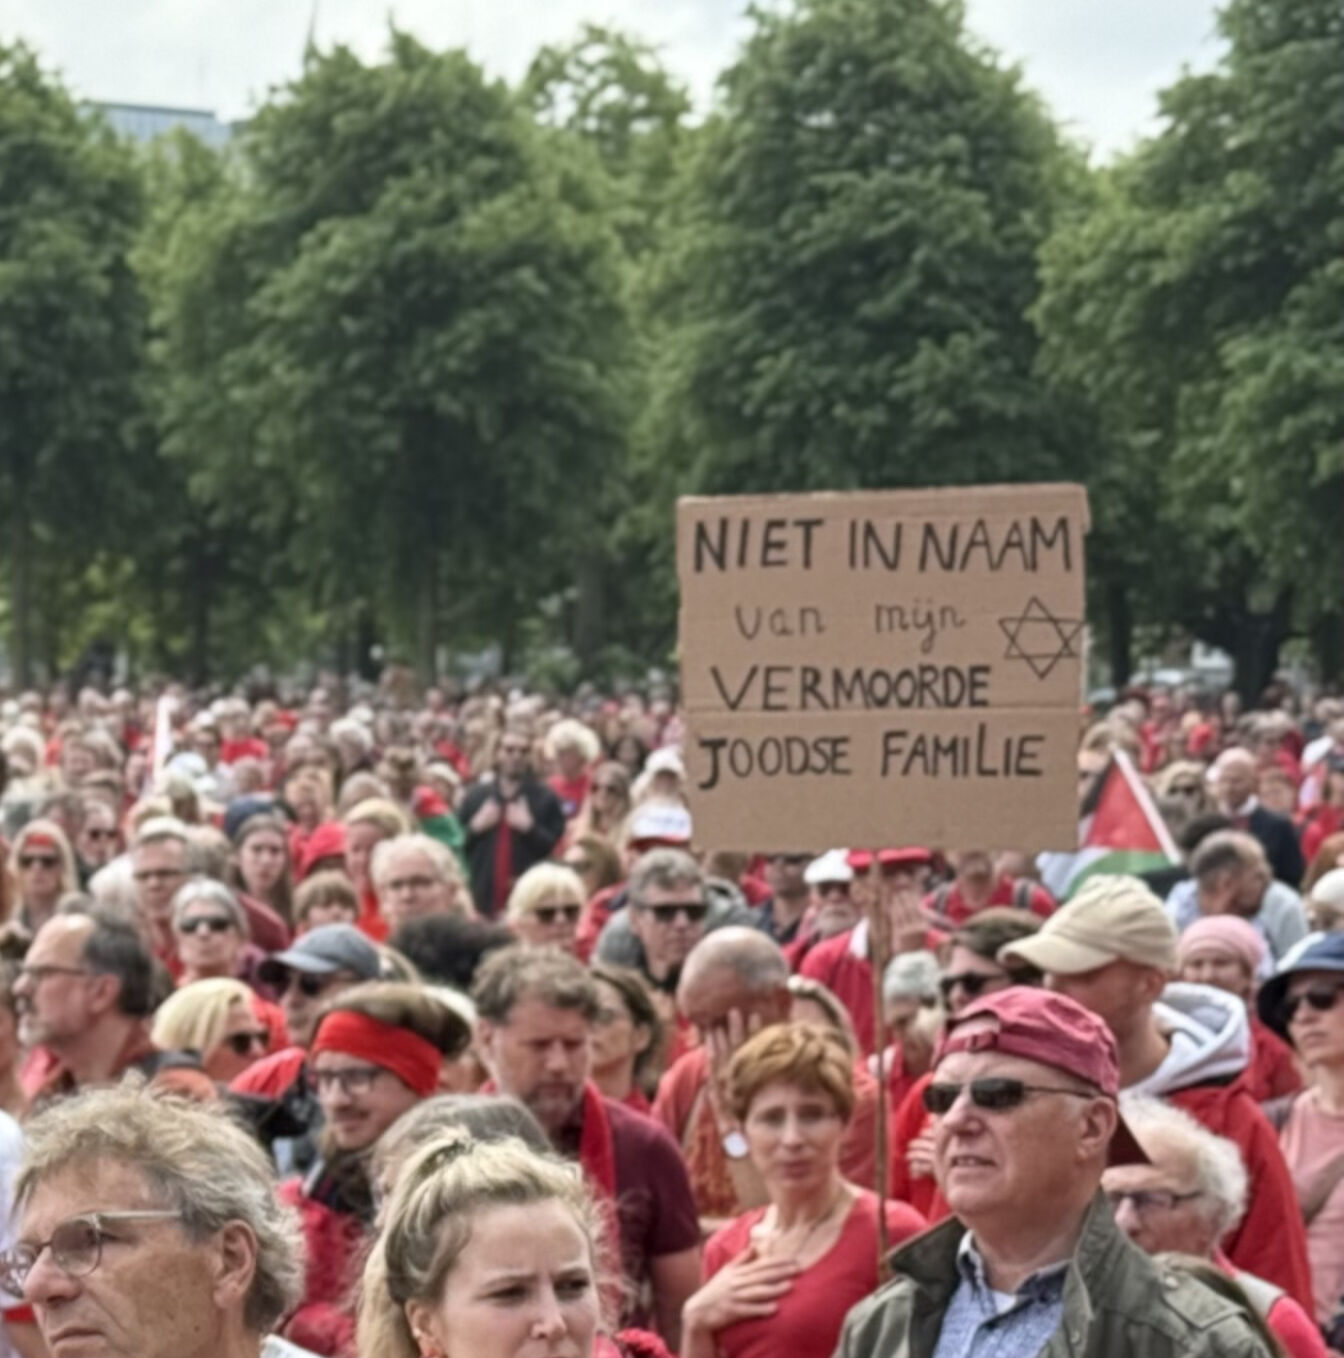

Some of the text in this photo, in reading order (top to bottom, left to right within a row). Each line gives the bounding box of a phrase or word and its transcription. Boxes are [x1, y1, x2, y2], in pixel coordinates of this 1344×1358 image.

[693, 516, 1073, 573] NIET IN NAAM
[734, 598, 967, 655] van mijn
[710, 663, 992, 712] VERMOORDE
[698, 722, 1046, 791] JOODSE FAMILIE
